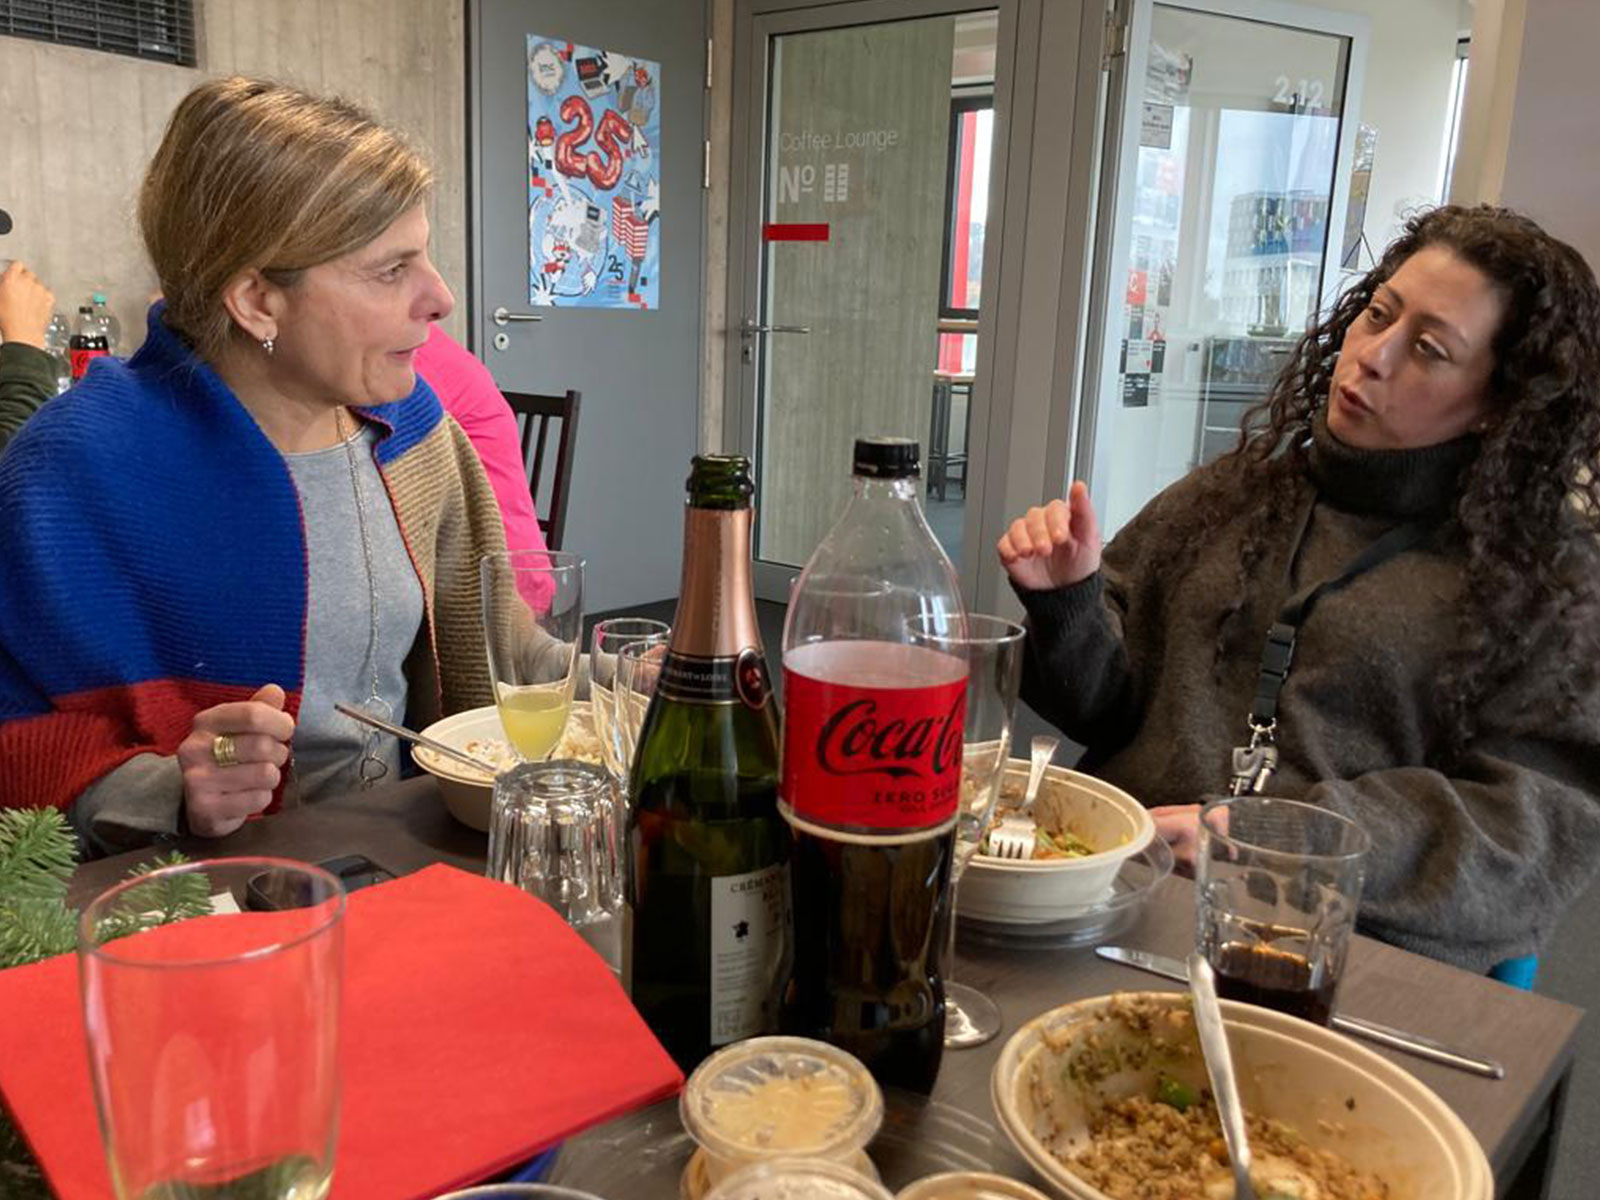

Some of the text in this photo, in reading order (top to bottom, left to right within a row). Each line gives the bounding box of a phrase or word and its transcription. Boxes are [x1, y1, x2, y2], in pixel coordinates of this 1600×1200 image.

[555, 94, 634, 191] 25
[780, 129, 899, 153] Coffee Lounge
[608, 254, 624, 281] 25
